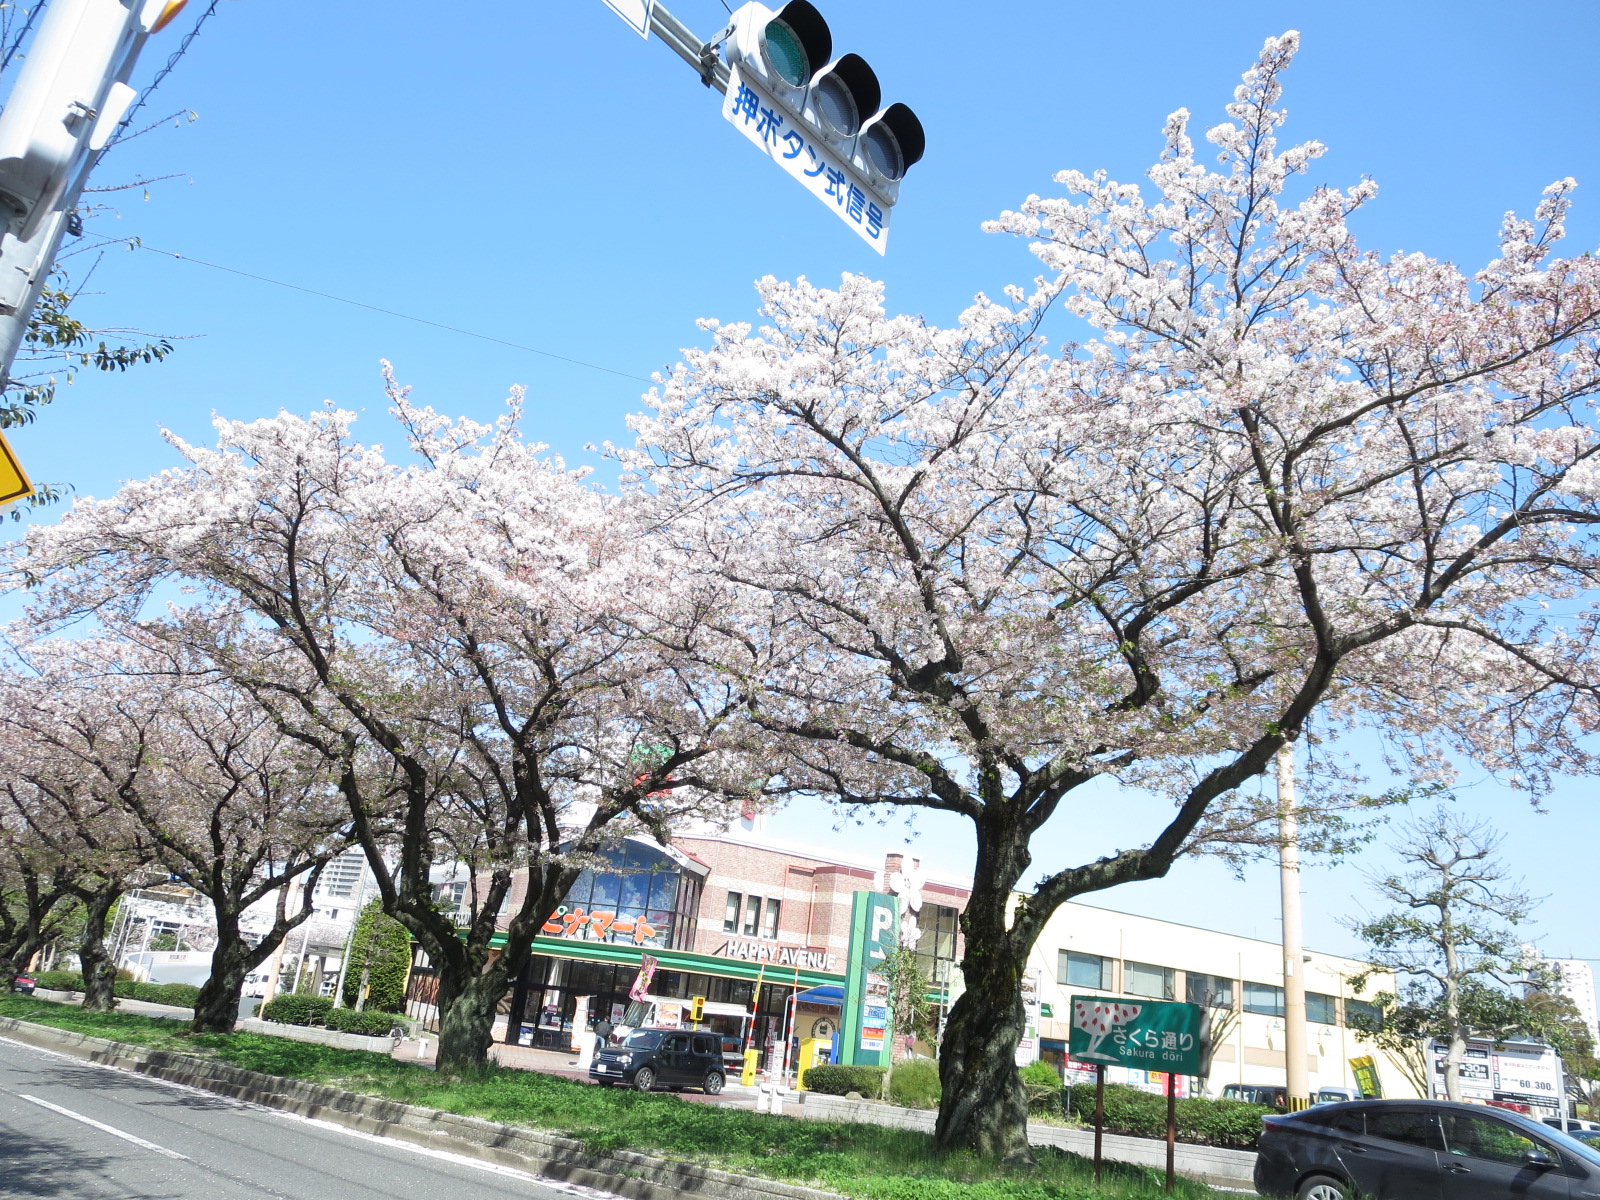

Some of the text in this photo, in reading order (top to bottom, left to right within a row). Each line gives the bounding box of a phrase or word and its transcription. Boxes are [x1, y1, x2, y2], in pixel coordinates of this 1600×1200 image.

[732, 81, 883, 239] 押ボタン式信号
[871, 905, 893, 942] P
[727, 940, 836, 970] HAPPY AVENUE
[1113, 1027, 1193, 1051] さくら通り
[1119, 1046, 1183, 1061] Sakura dōri
